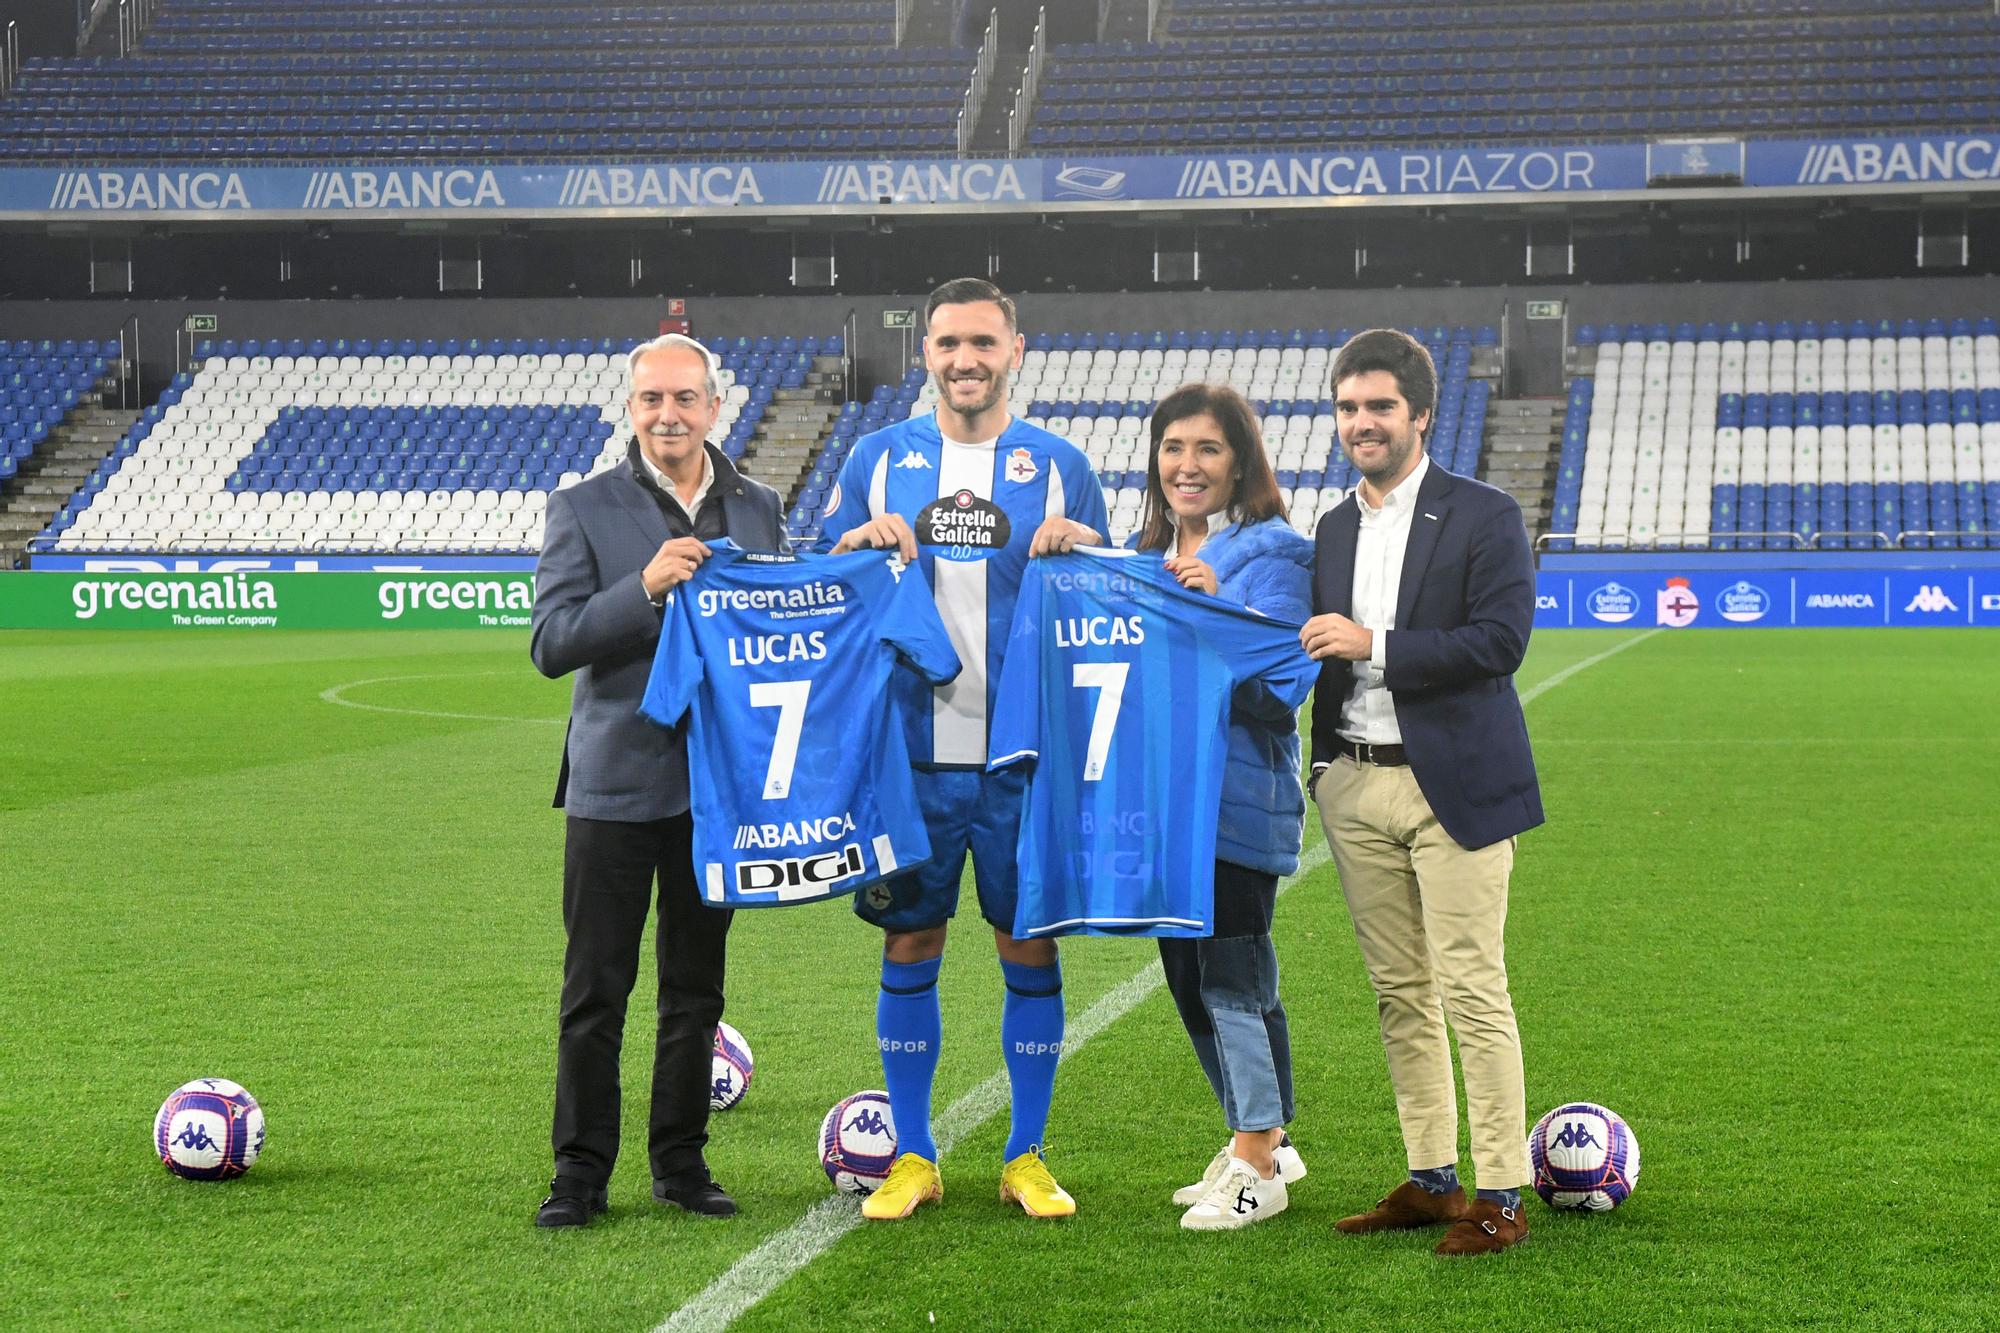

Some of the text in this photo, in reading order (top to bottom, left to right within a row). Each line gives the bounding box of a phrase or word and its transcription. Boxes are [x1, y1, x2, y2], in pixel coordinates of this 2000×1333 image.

[1401, 151, 1596, 192] RIAZOR
[930, 507, 996, 528] Estrella
[931, 523, 992, 545] Galicia
[72, 572, 277, 619] greenalia
[698, 580, 845, 617] greenalia
[770, 604, 846, 620] The Green Company
[172, 614, 278, 627] The Green Company
[478, 614, 498, 626] The
[1055, 615, 1145, 648] LUCAS
[728, 631, 828, 667] LUCAS
[1072, 662, 1131, 781] 7
[749, 679, 812, 800] 7
[739, 846, 861, 890] DIGI
[1015, 1041, 1064, 1055] DÉPO
